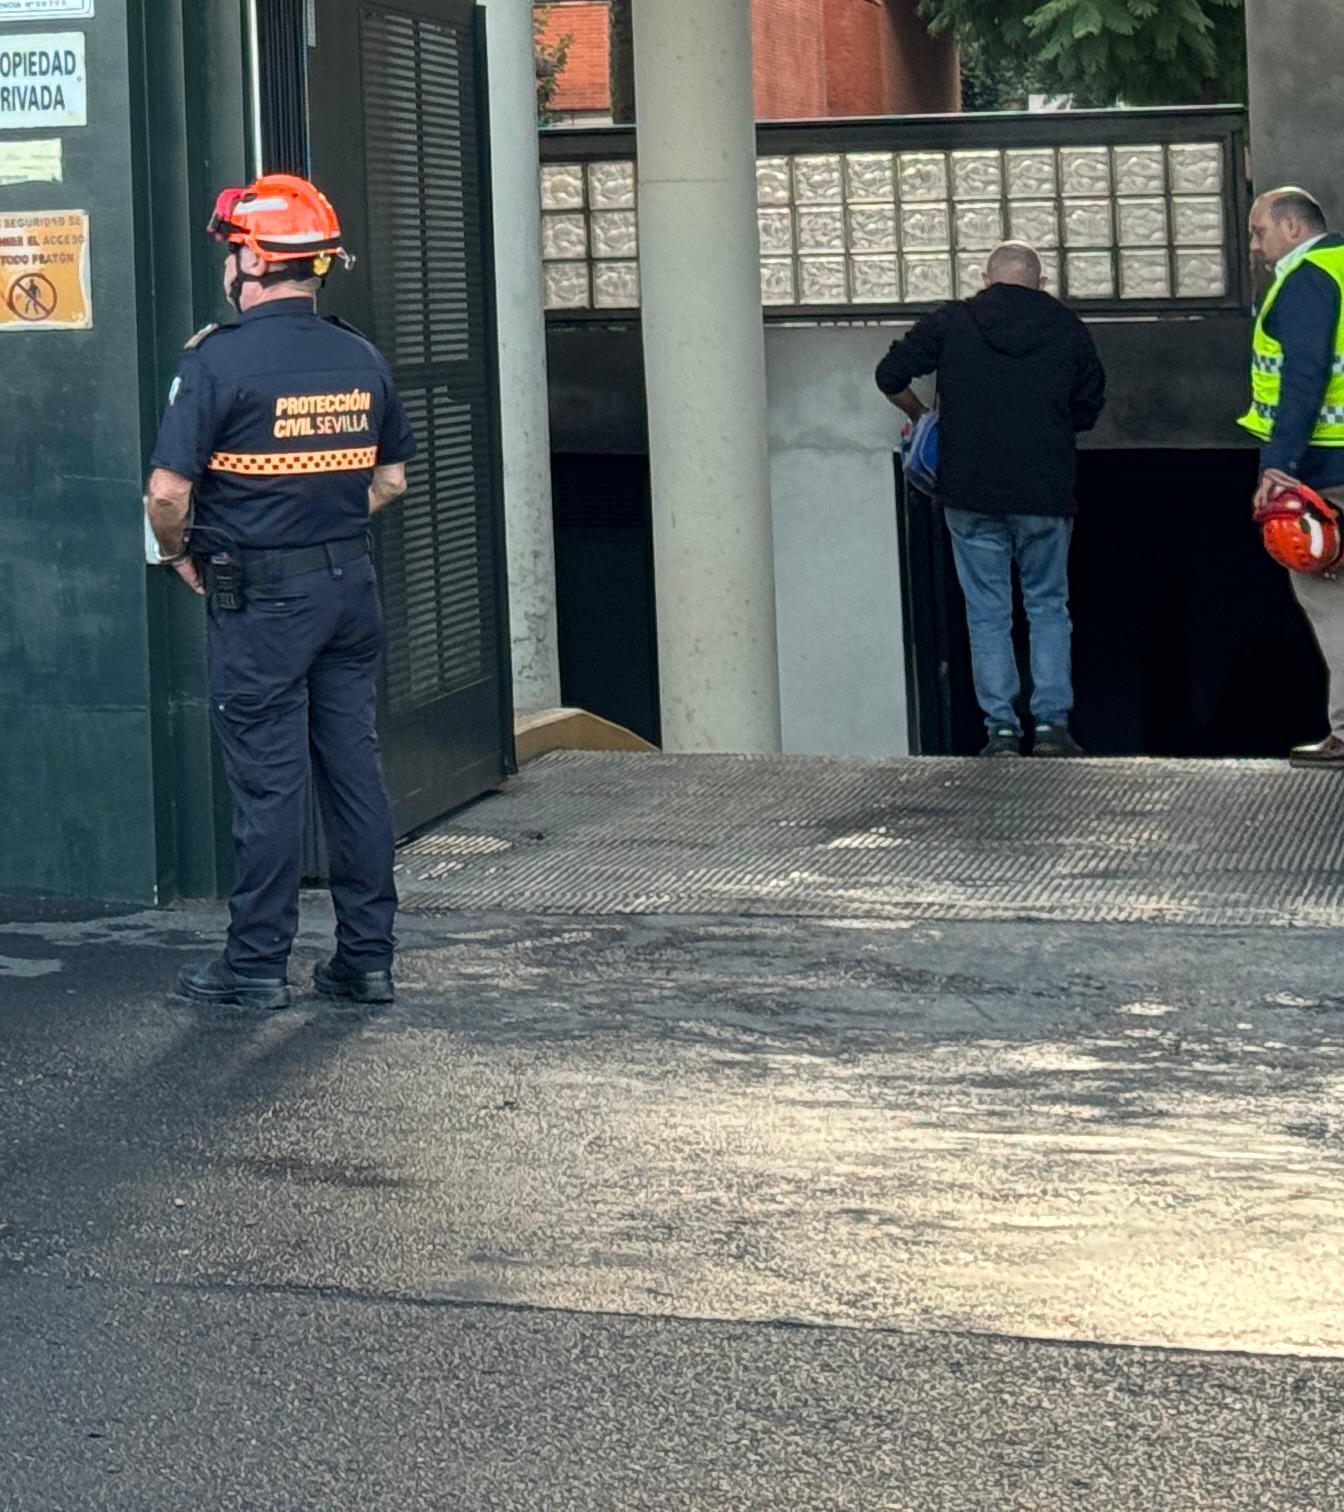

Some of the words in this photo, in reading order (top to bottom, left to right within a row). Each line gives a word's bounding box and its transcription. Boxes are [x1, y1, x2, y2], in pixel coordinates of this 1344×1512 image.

[4, 216, 65, 229] SEGURIDAD
[68, 215, 82, 226] SE
[27, 236, 40, 246] EL
[43, 234, 85, 245] ACCESO
[0, 255, 29, 266] TODO
[275, 388, 371, 416] PROTECCIÓN
[273, 417, 315, 438] CIVIL
[316, 414, 369, 434] SEVILLA
